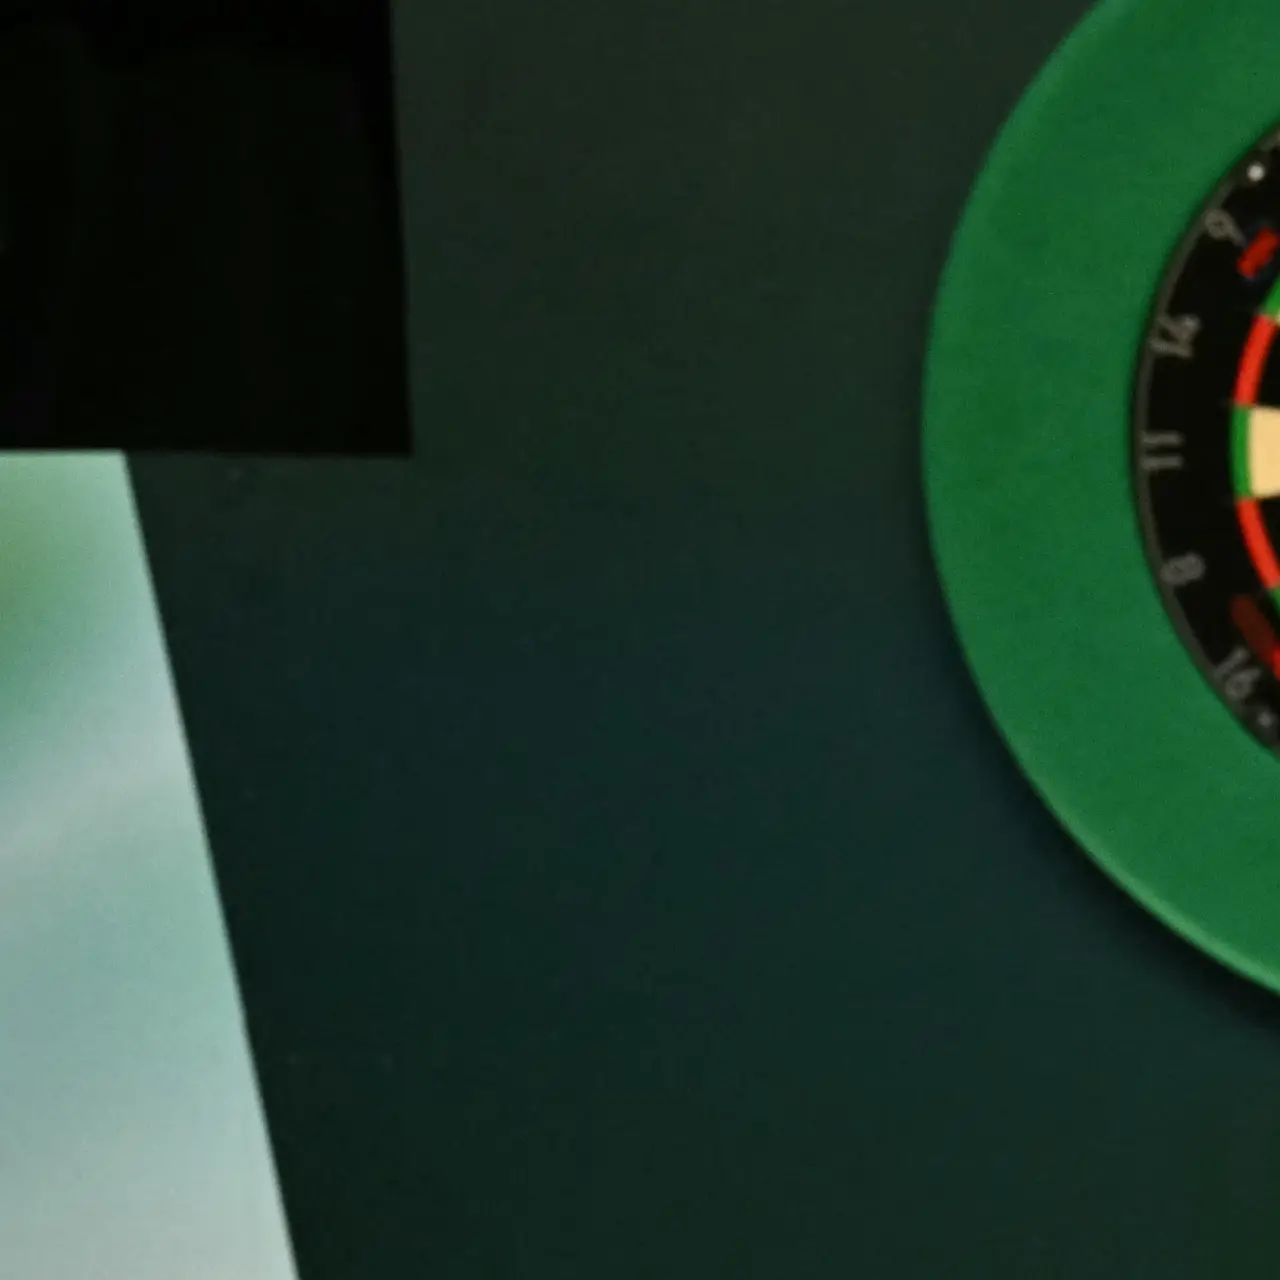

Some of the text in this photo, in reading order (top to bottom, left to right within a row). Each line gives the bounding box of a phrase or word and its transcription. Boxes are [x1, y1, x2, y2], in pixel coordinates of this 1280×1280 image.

[1204, 211, 1240, 243] 9
[1147, 312, 1201, 358] 14
[1140, 430, 1185, 471] 11
[1213, 646, 1263, 698] 16
